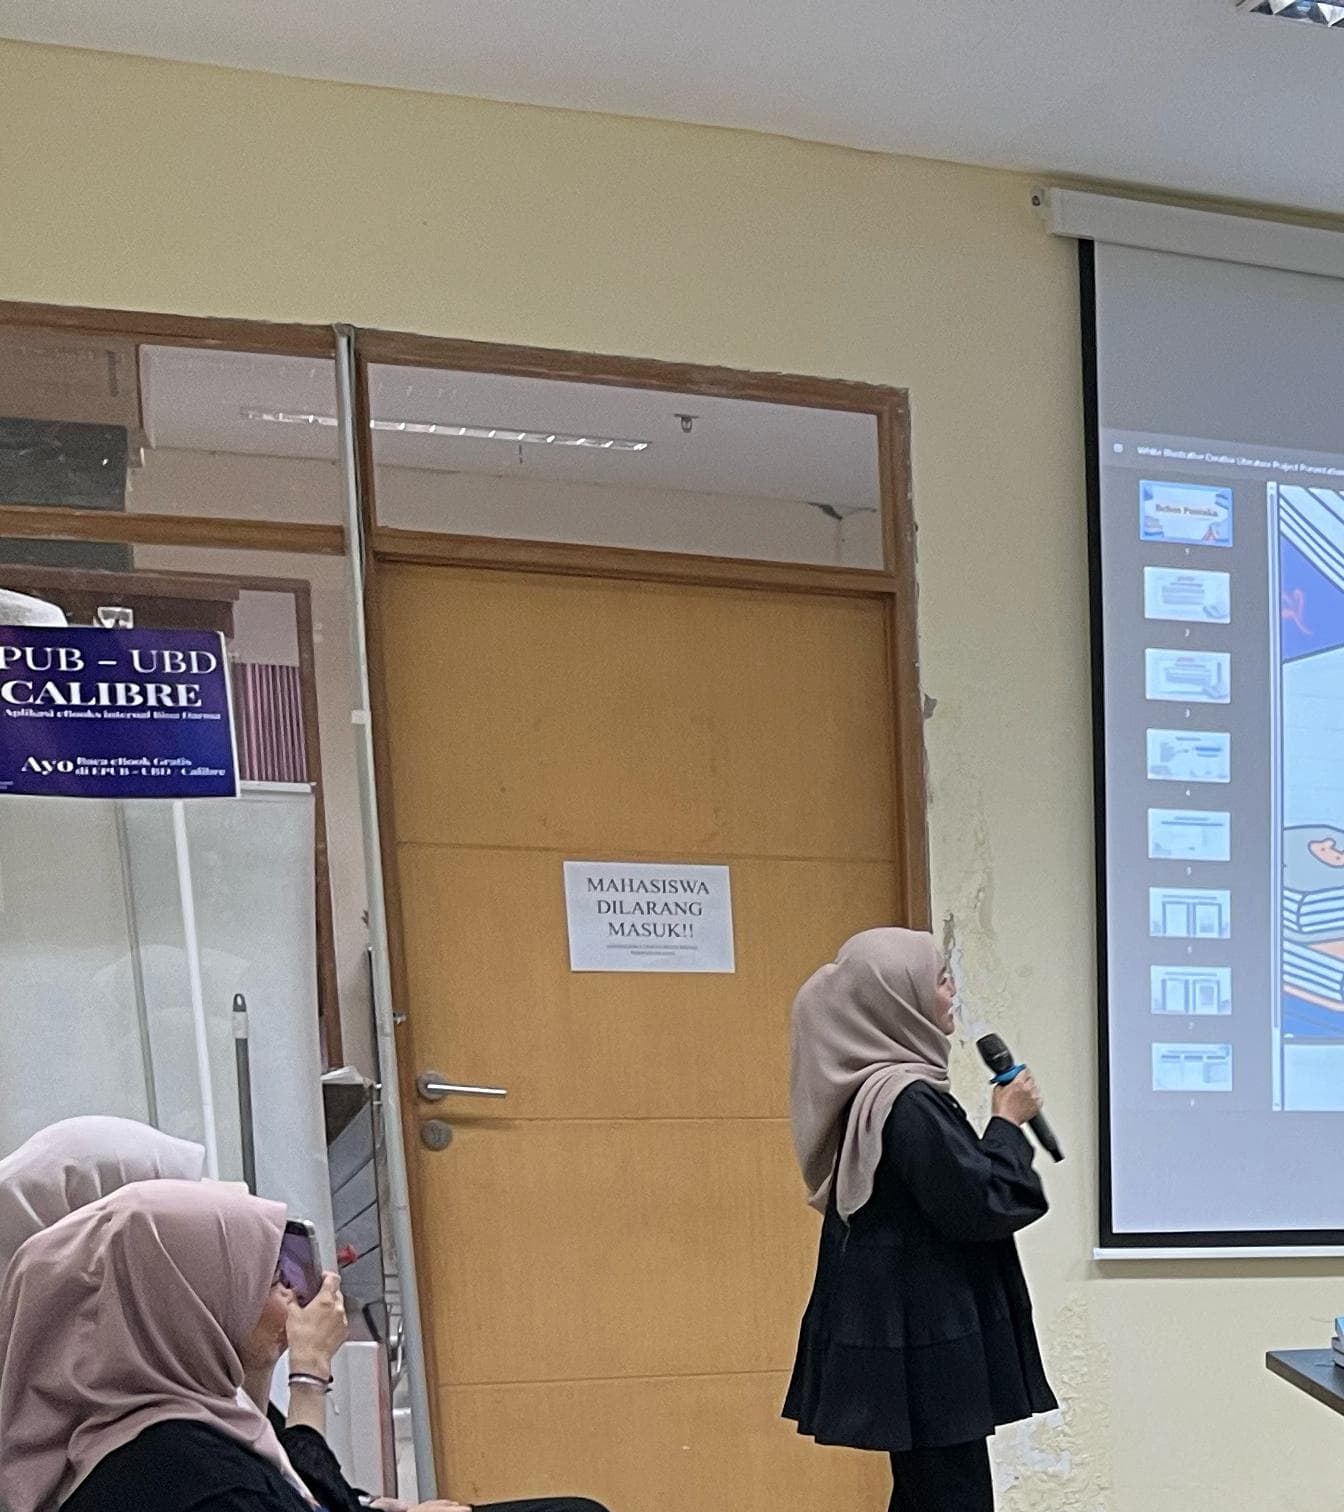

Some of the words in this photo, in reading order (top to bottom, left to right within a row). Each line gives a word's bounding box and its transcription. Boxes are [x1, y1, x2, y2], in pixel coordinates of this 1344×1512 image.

[130, 649, 217, 674] UBD
[1, 680, 202, 707] CALIBRE
[21, 756, 74, 776] Ayo
[586, 877, 710, 895] MAHASISWA
[597, 900, 703, 916] DILARANG
[608, 922, 694, 938] MASUK!!
